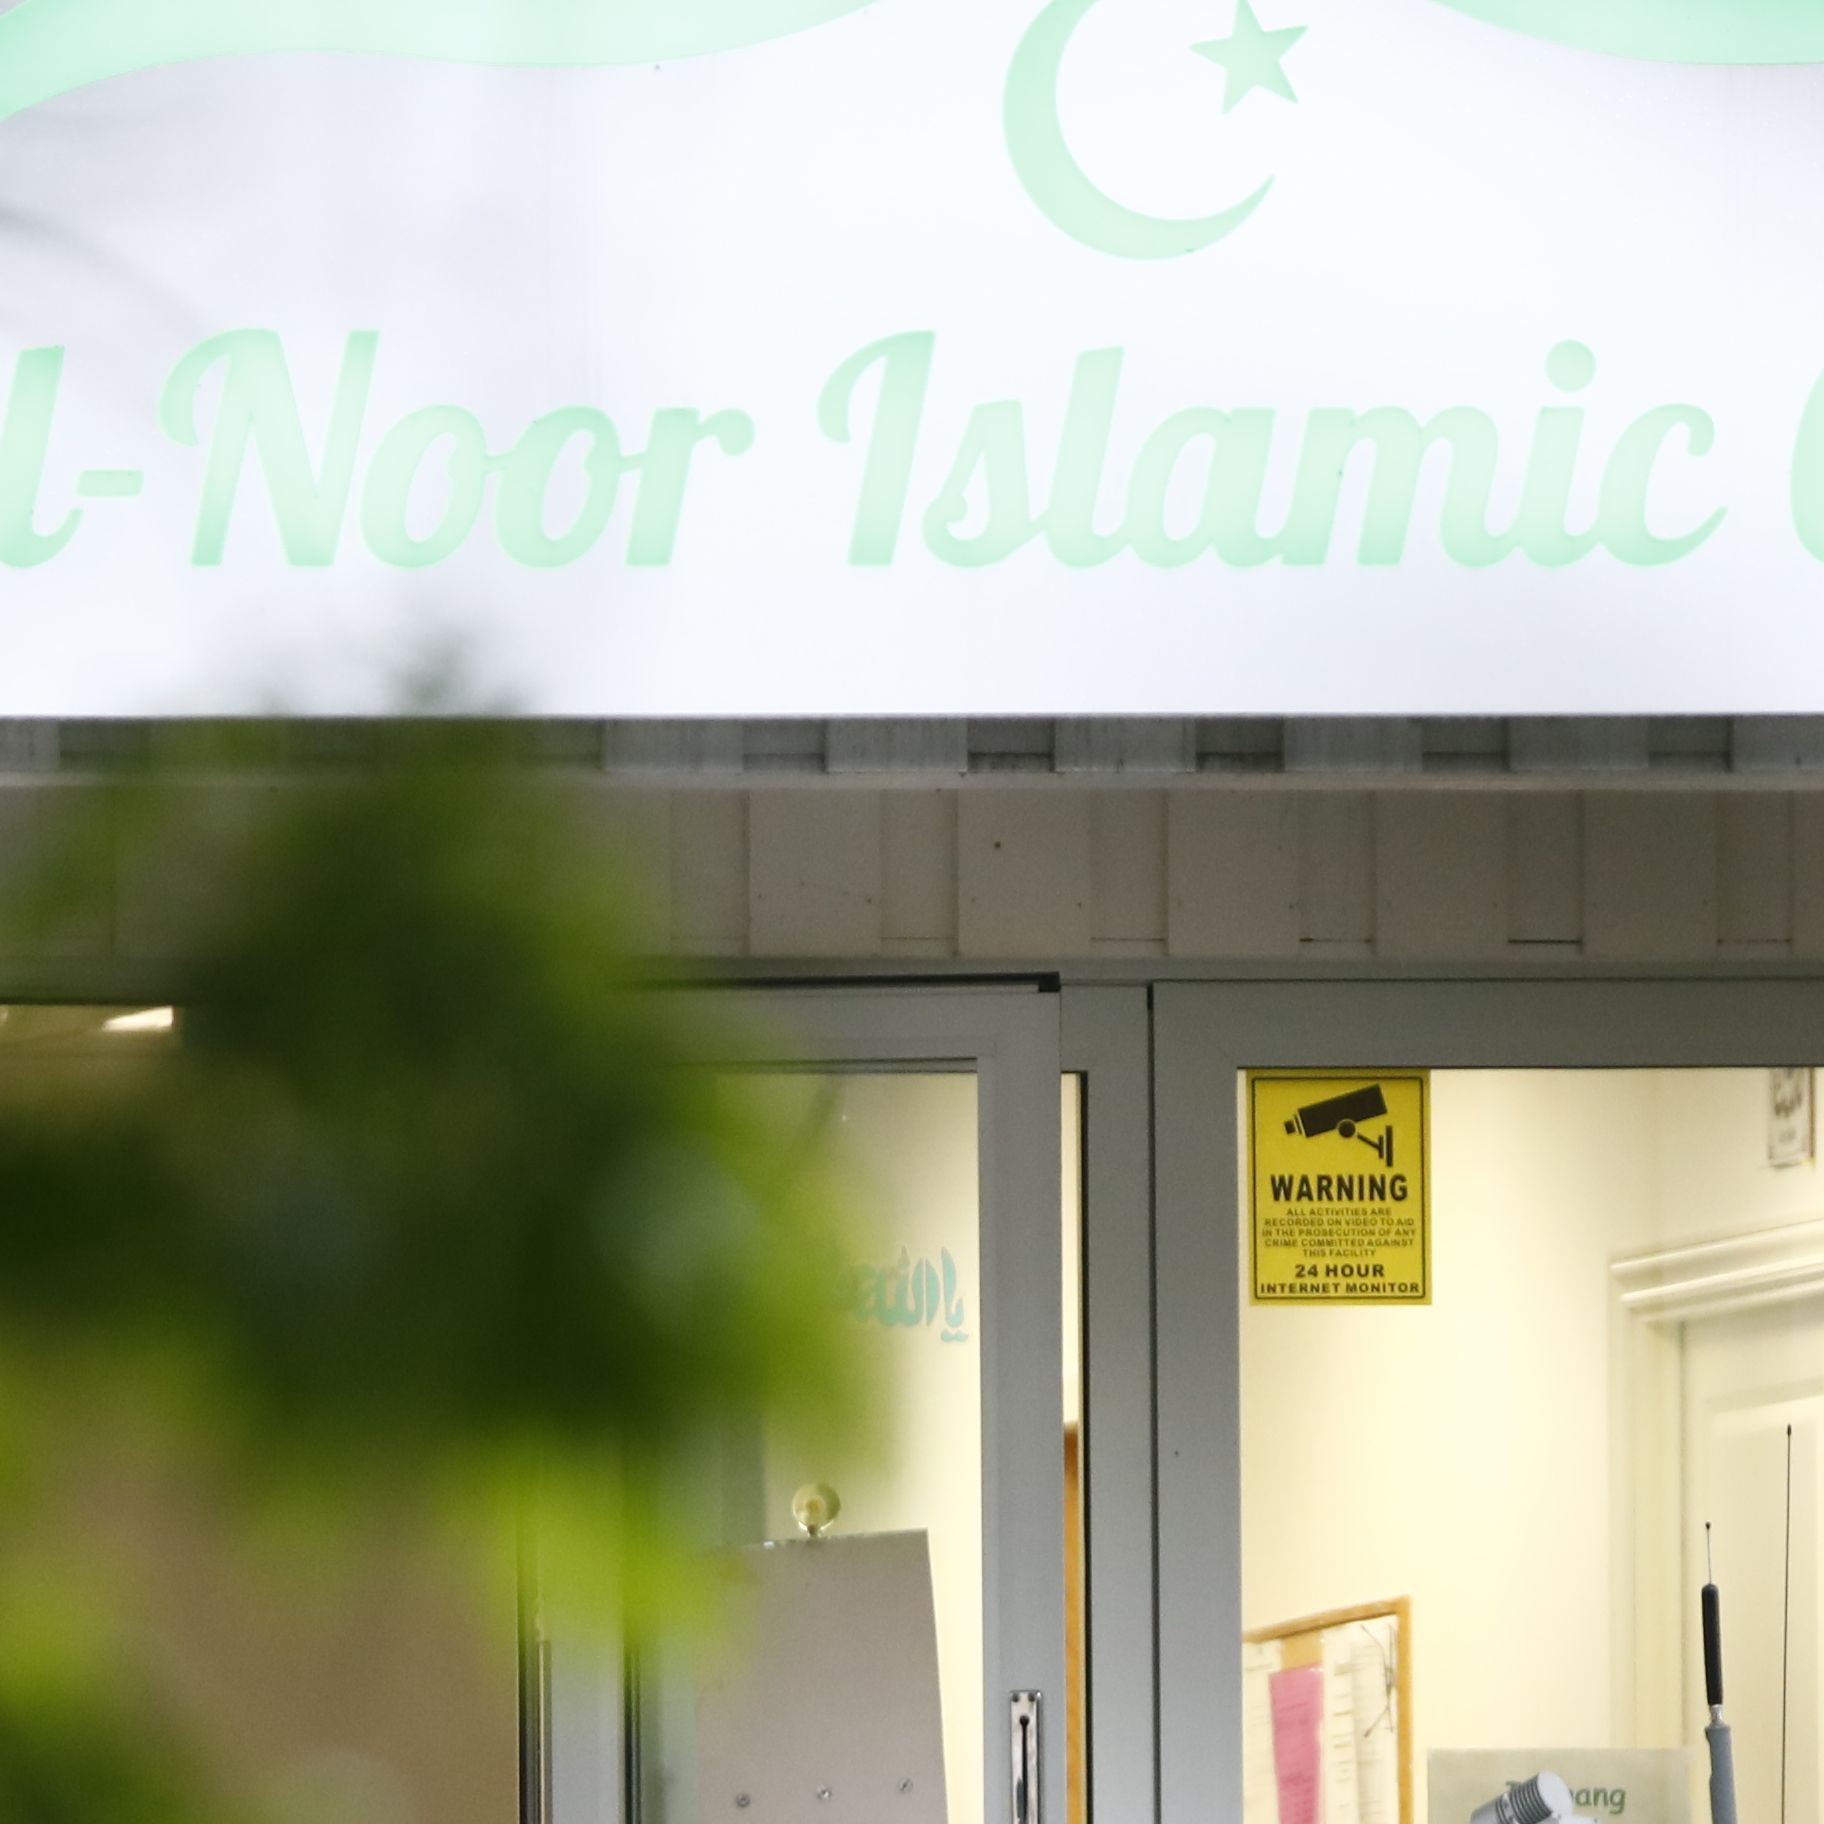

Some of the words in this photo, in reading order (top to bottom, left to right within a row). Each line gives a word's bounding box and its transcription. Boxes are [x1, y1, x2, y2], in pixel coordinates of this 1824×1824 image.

[816, 329, 1728, 572] Islamic
[1270, 1174, 1409, 1202] WARNING
[1286, 1207, 1306, 1216] ALL
[1309, 1207, 1368, 1216] ACTIVITIES
[1370, 1207, 1392, 1216] ARE
[1264, 1218, 1324, 1227] RECORDED
[1327, 1218, 1342, 1226] ON
[1344, 1218, 1378, 1227] VIDEO
[1380, 1217, 1394, 1226] TO
[1396, 1217, 1415, 1226] AID
[1262, 1228, 1272, 1237] IN
[1275, 1228, 1295, 1237] THE
[1298, 1228, 1376, 1237] PROSECUTION
[1378, 1228, 1392, 1237] OF
[1394, 1228, 1416, 1237] ANY
[1264, 1239, 1297, 1248] CRIME
[1301, 1238, 1365, 1247] COMMITTED
[1366, 1238, 1414, 1247] AGAINST
[1303, 1249, 1326, 1257] THIS
[1329, 1249, 1376, 1257] FACILITY
[1295, 1264, 1318, 1278] 24
[1325, 1264, 1384, 1278] HOUR
[1261, 1282, 1340, 1294] INTERNET
[1345, 1282, 1419, 1294] MONITOR
